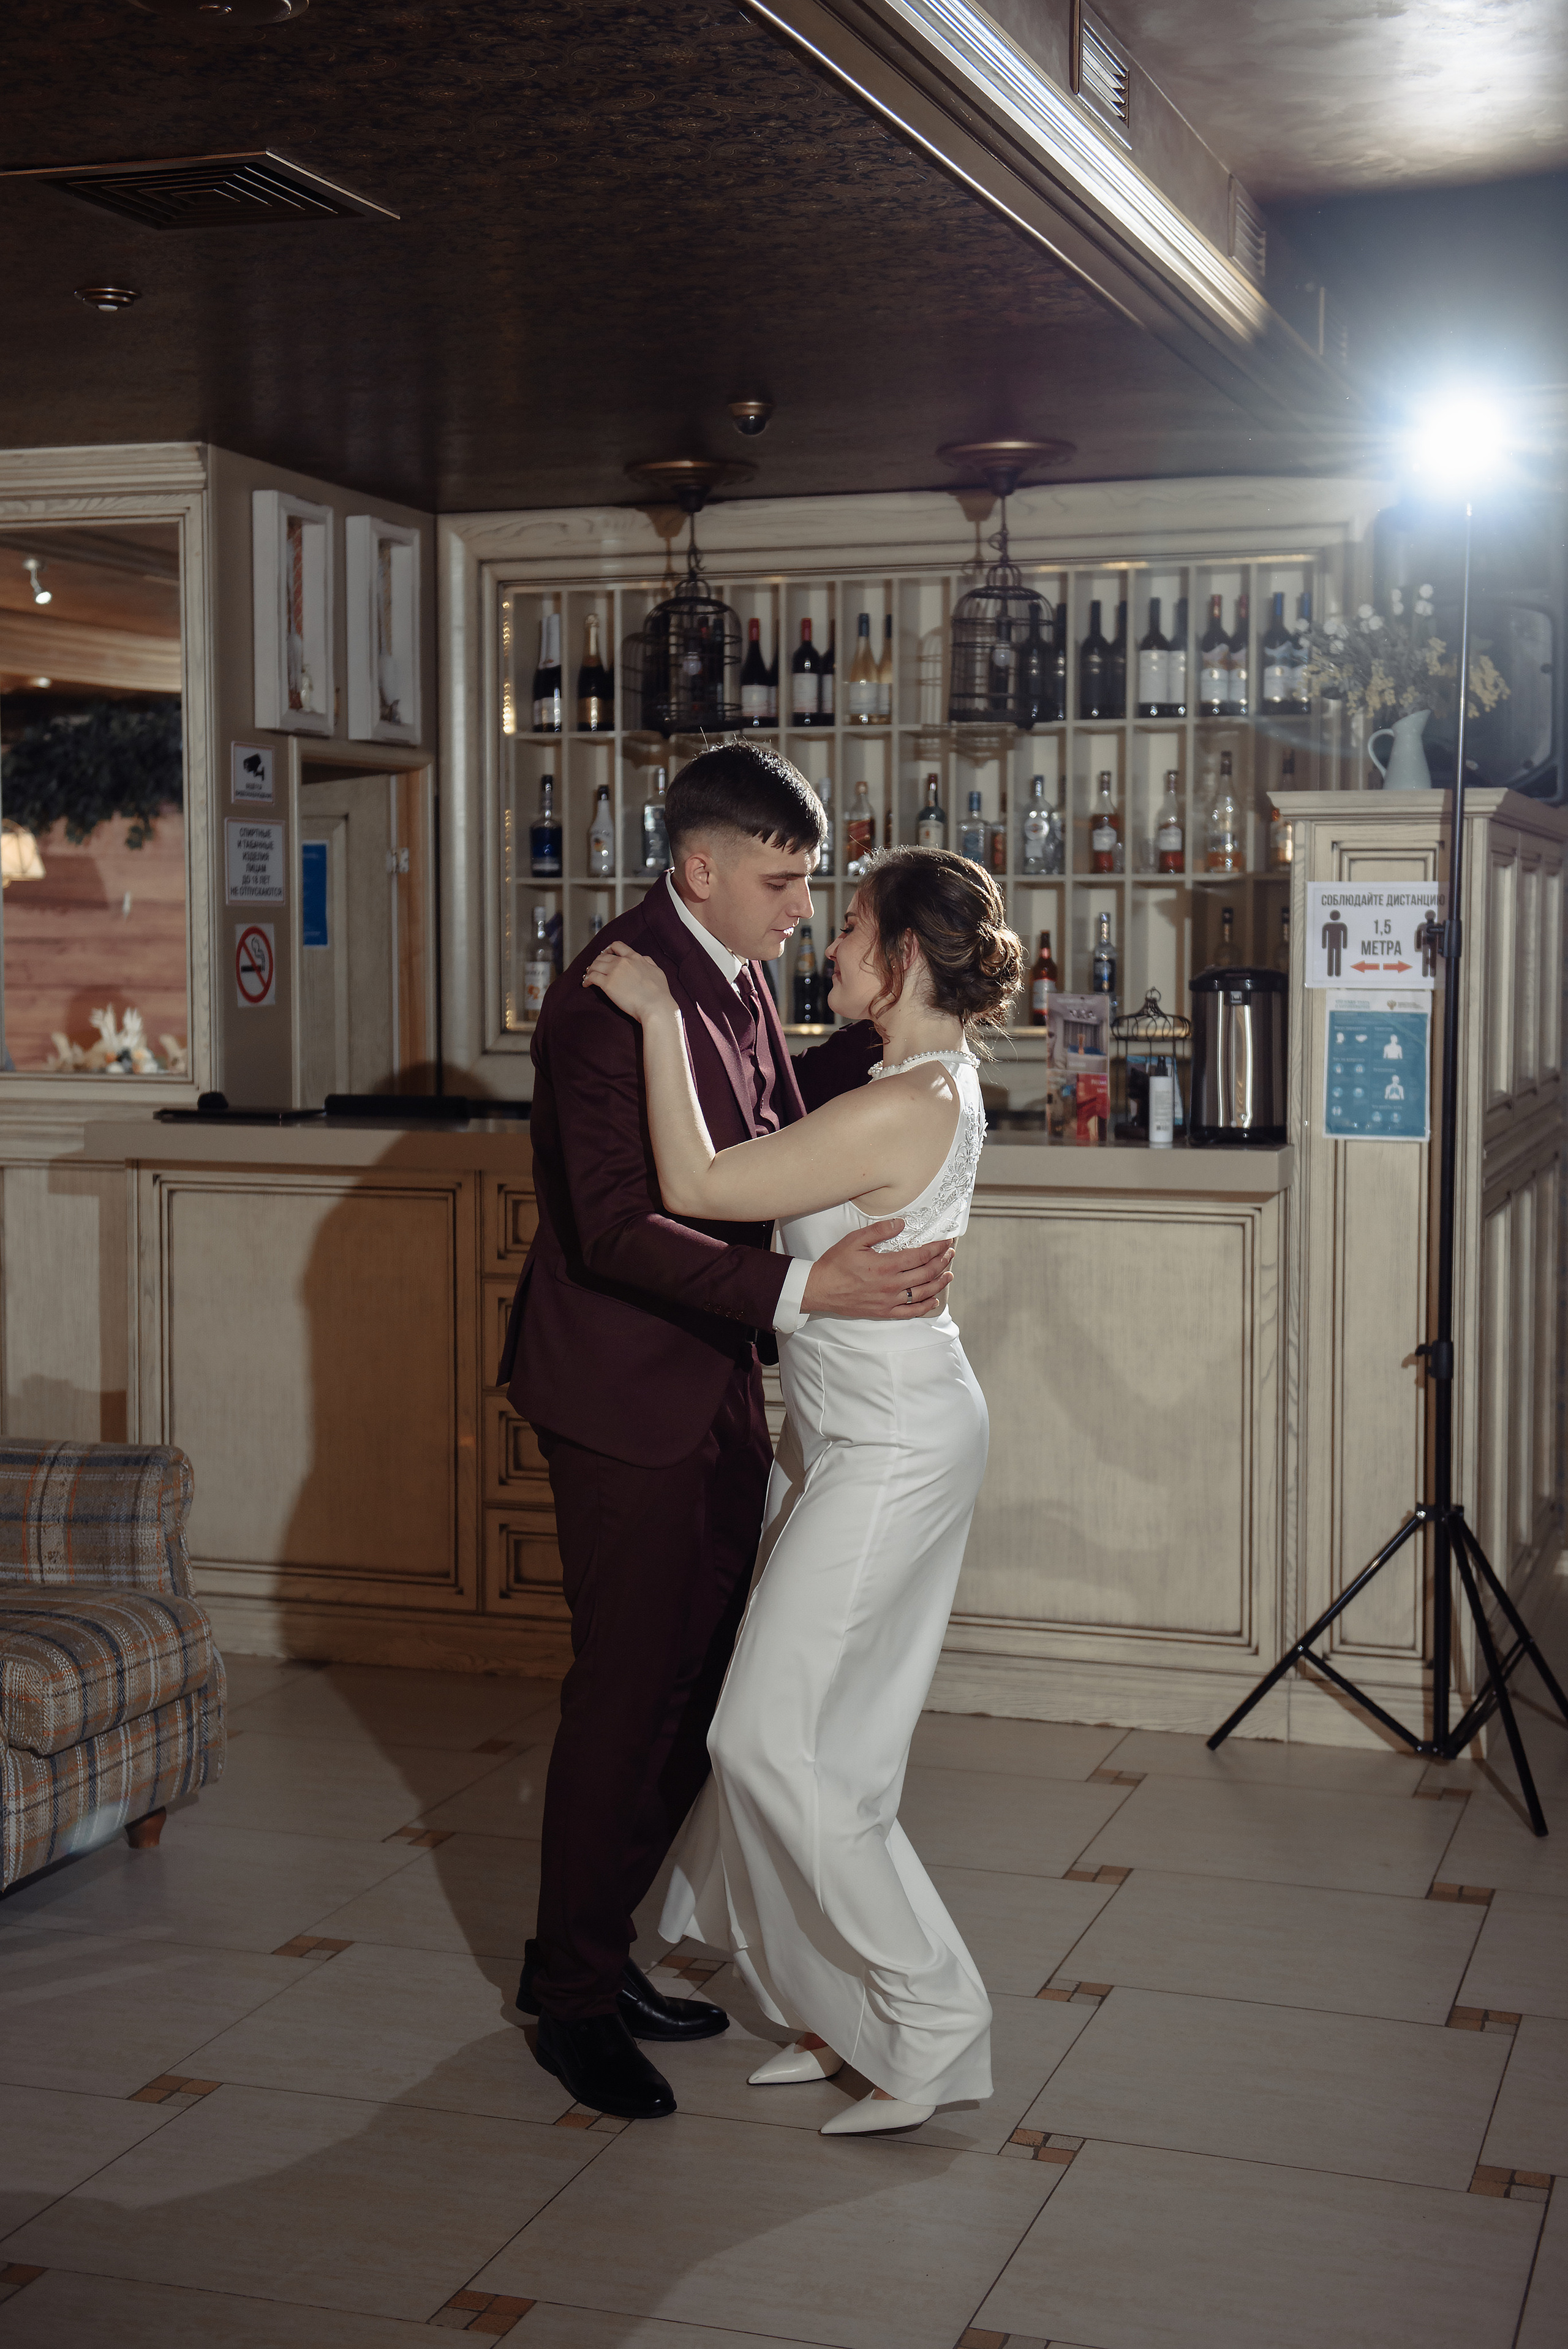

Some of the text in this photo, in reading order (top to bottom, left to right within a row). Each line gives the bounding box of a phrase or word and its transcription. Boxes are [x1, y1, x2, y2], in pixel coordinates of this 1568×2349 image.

[239, 828, 271, 838] СПИРТНЫЕ
[243, 852, 270, 861] ИЗДЕЛИЯ
[246, 863, 266, 873] ЛИЦАМ
[242, 876, 271, 885] ДО 18 ЛЕТ
[230, 886, 282, 897] НЕ ОТПУСКАЮТСЯ
[1321, 892, 1446, 907] СОБЛЮДАЙТЕ ДИСТАНЦИЮ
[1373, 919, 1392, 936] 1,5
[1361, 940, 1402, 956] МЕТРА
